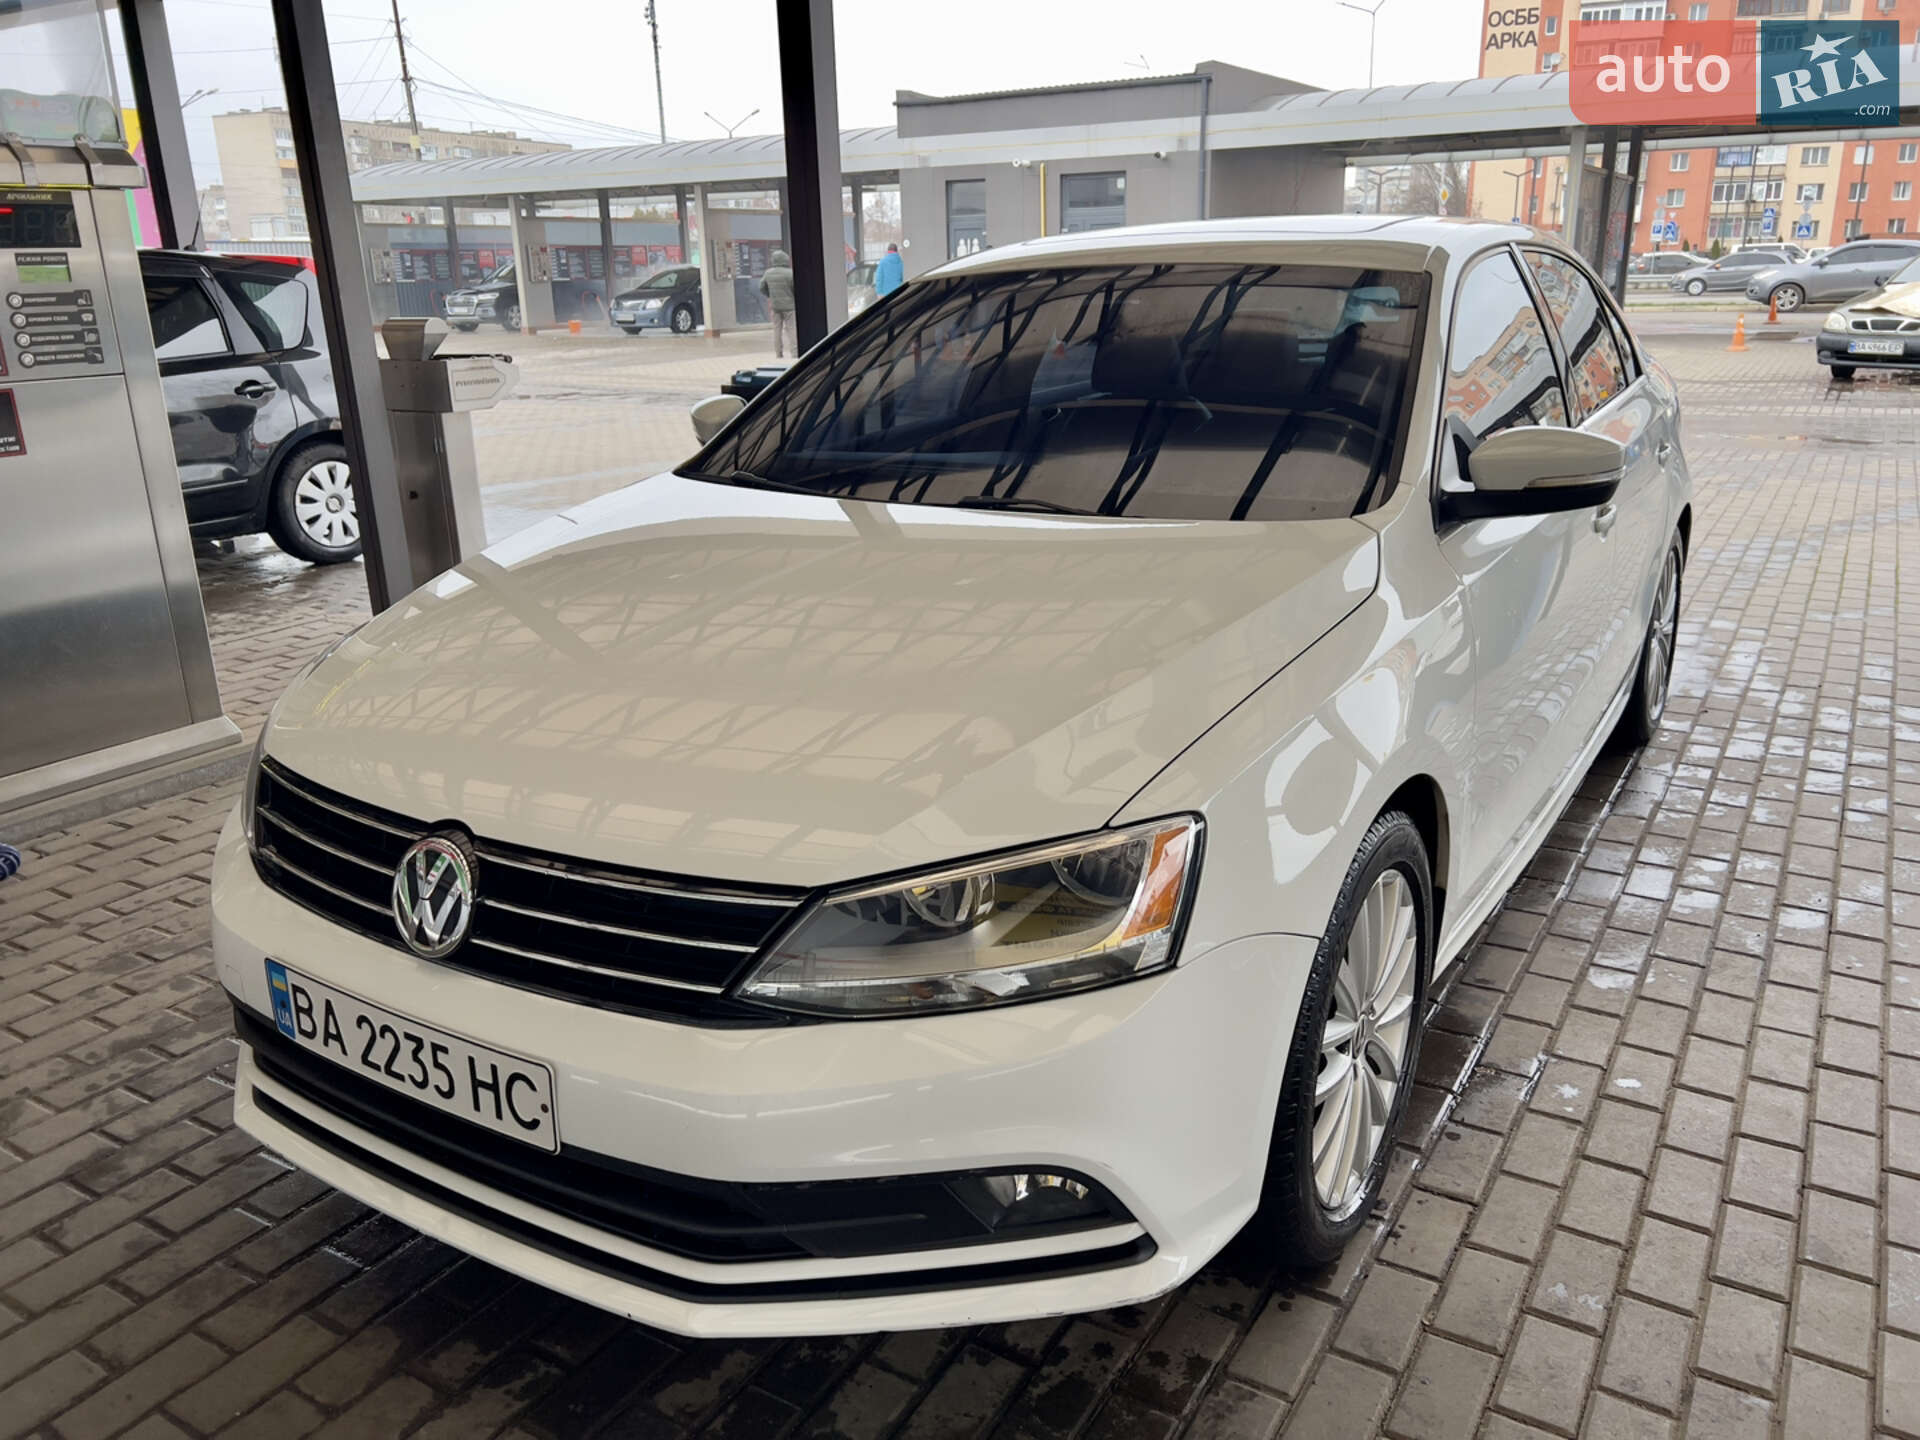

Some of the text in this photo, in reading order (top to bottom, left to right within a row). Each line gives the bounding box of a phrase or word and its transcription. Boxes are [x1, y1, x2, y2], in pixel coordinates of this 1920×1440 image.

[1488, 7, 1540, 28] ОСББ
[1485, 30, 1538, 50] АРКА
[277, 1008, 294, 1030] UA
[291, 983, 541, 1131] BA 2235 HC
